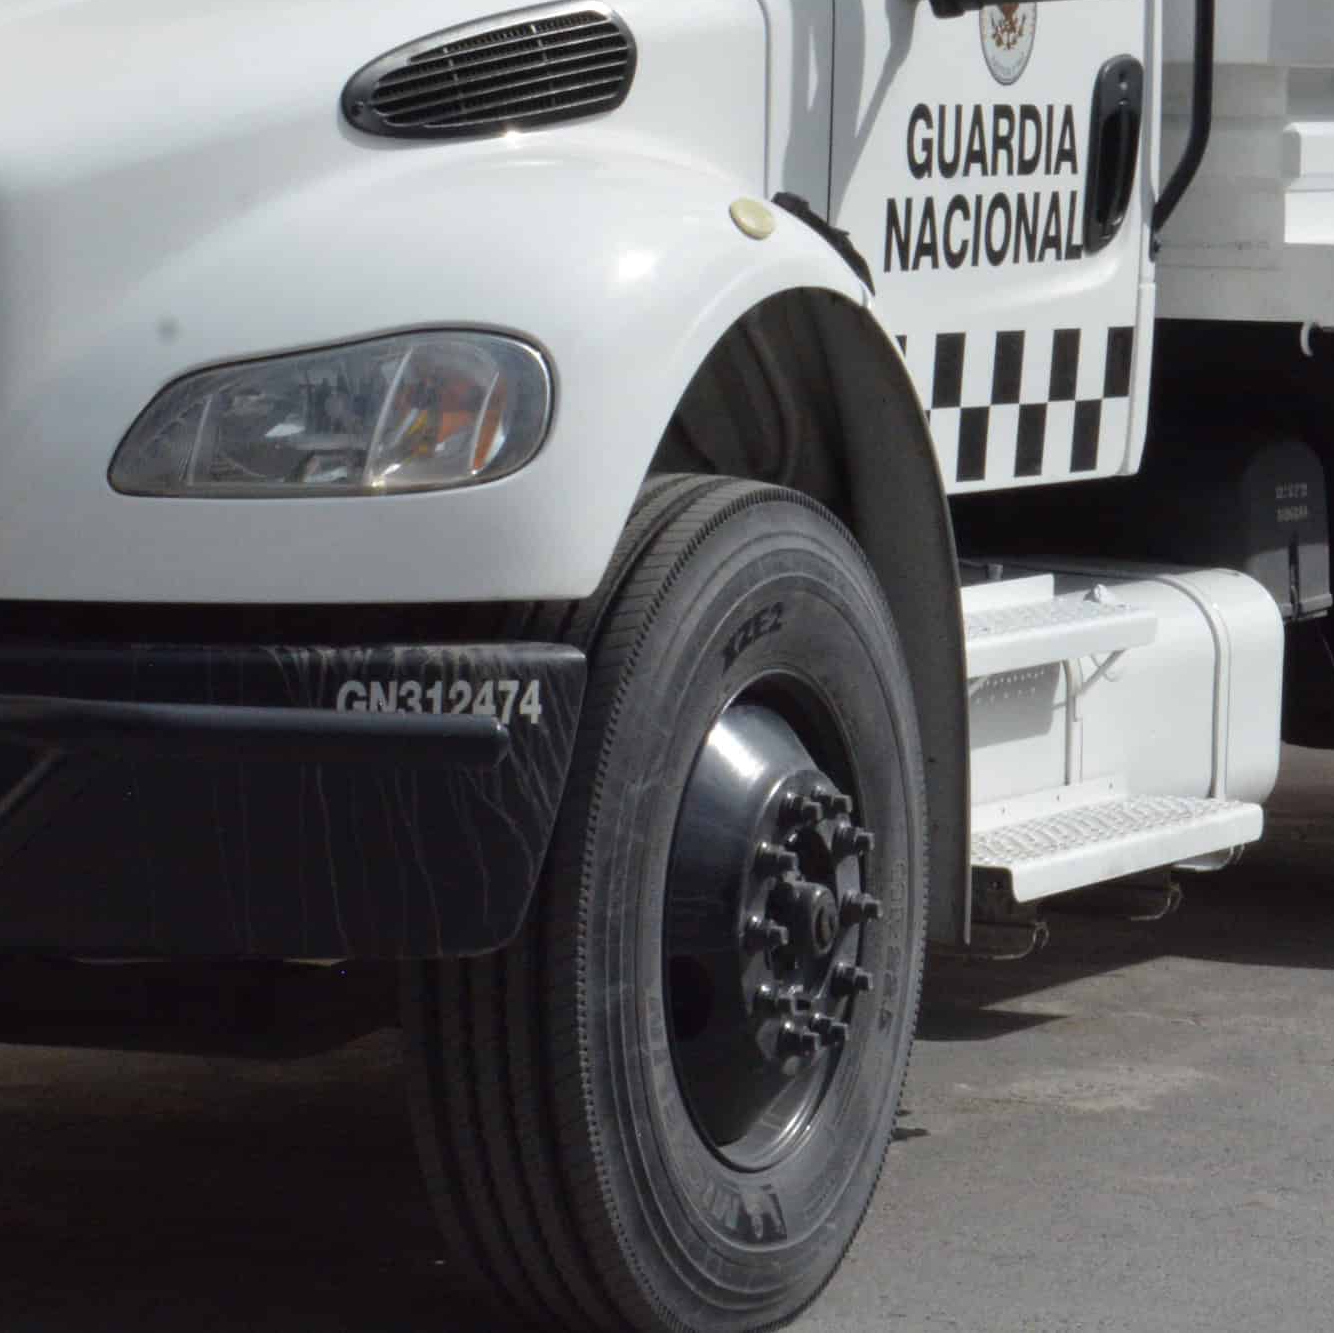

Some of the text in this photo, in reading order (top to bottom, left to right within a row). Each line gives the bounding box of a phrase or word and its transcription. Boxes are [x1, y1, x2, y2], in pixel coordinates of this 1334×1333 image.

[907, 103, 1078, 179] GUARDIA
[884, 190, 1084, 273] NACIONAL
[722, 601, 785, 676] XZE2
[336, 678, 543, 725] GN312474
